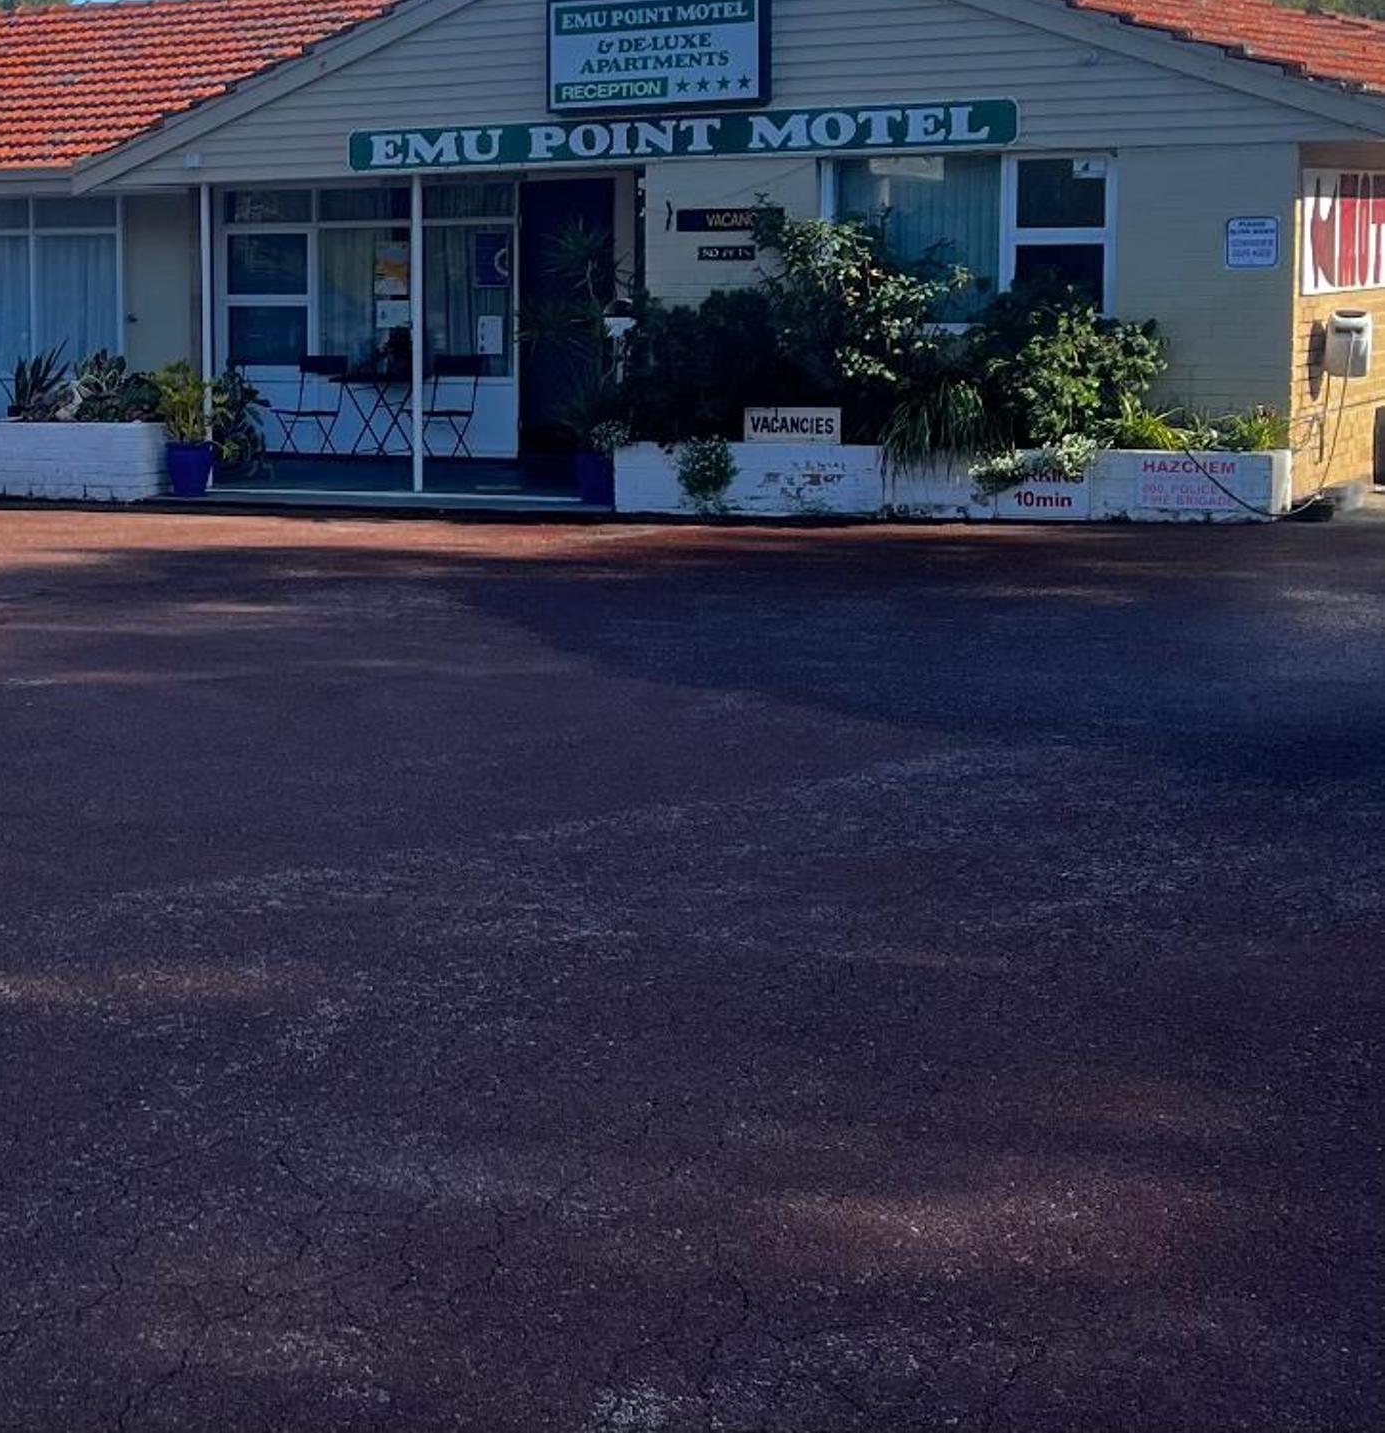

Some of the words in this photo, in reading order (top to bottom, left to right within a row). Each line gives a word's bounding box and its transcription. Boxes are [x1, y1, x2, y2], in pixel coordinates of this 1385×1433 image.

[561, 9, 607, 30] EMU
[611, 7, 673, 26] POINT
[676, 0, 748, 22] MOTEL
[598, 40, 614, 54] &
[580, 50, 730, 74] APARTMENTS
[561, 80, 661, 100] RECEPTION
[370, 129, 503, 165] EMU
[528, 118, 721, 158] POINT
[747, 106, 991, 149] MOTEL
[706, 212, 759, 228] VACANC
[750, 416, 834, 434] VACANCIES
[1142, 460, 1236, 475] HAZCHEM
[1014, 491, 1073, 508] 10min
